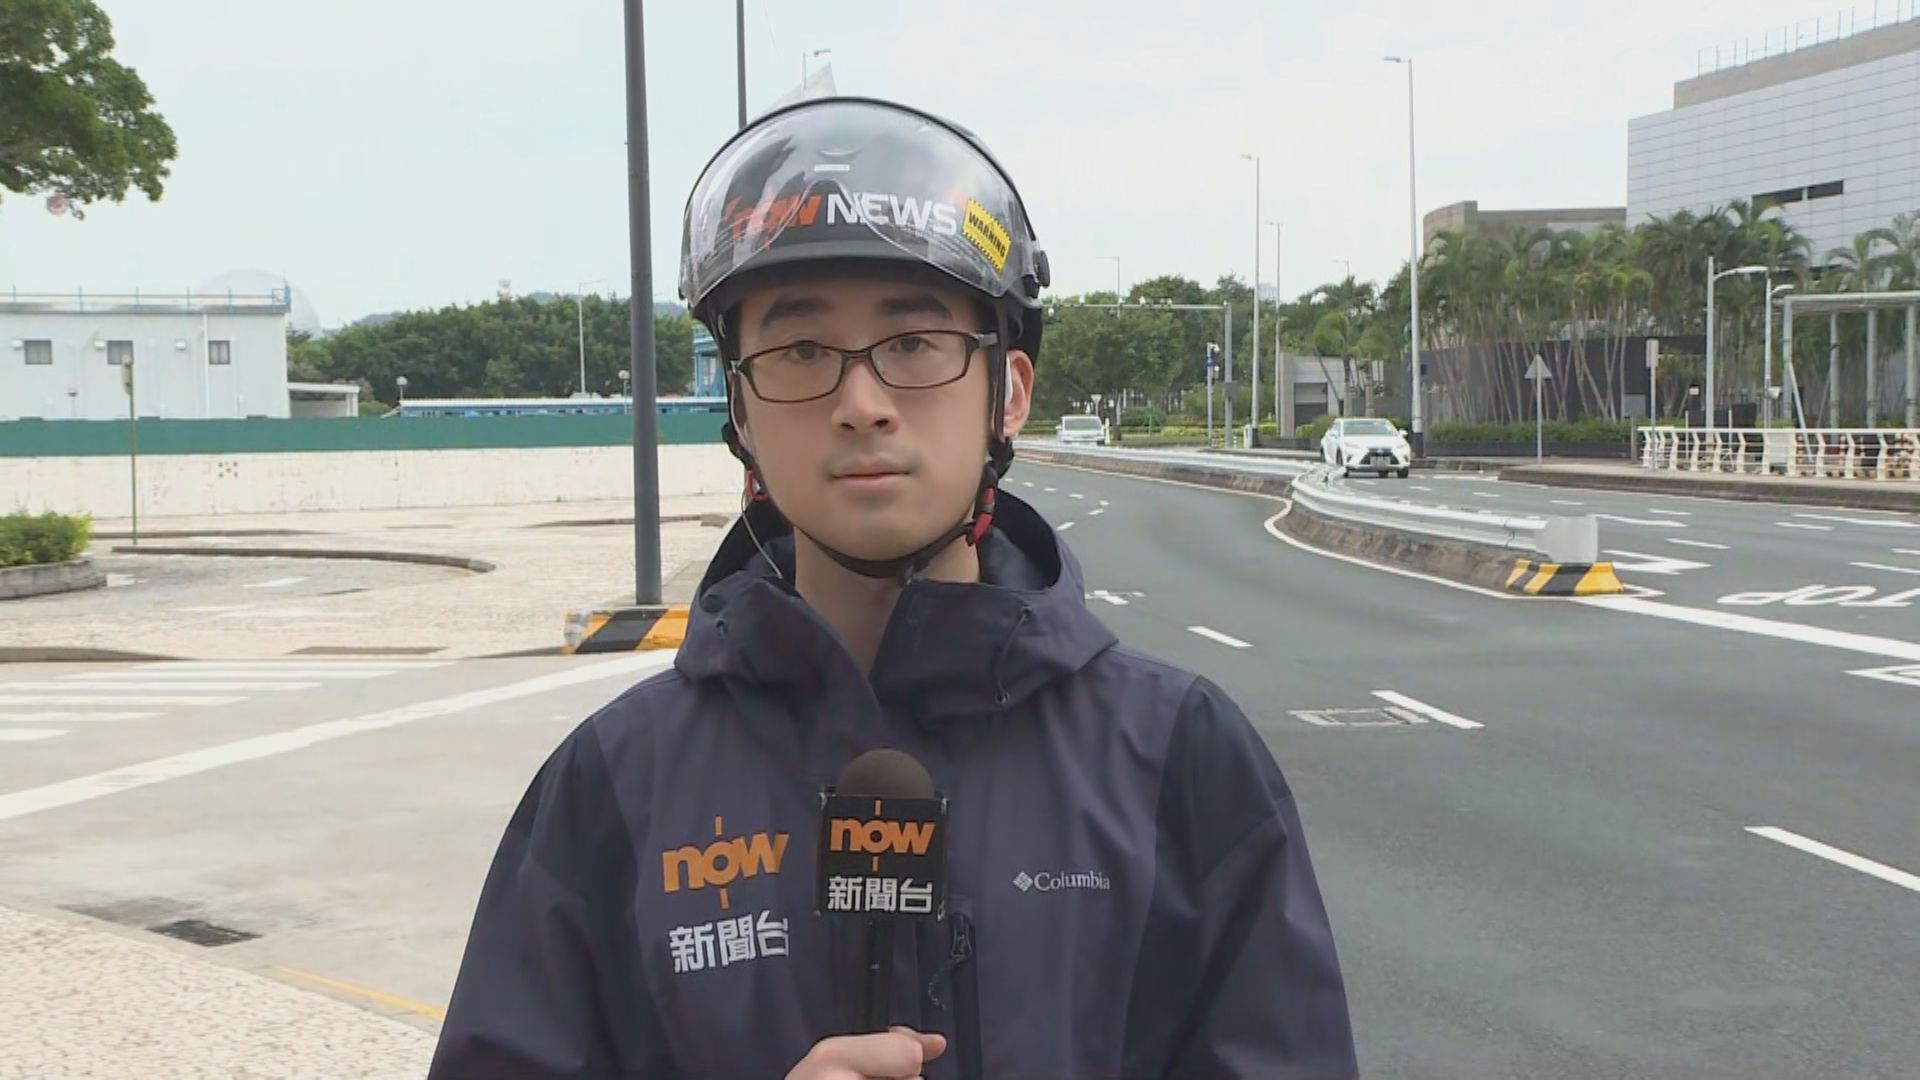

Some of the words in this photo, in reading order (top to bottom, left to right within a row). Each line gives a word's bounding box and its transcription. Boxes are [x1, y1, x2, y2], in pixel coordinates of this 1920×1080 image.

[826, 193, 958, 236] NEWS
[968, 211, 1006, 258] WARNING
[830, 812, 936, 860] now
[662, 826, 789, 899] now
[1033, 870, 1110, 891] Columbia
[827, 875, 933, 914] 新聞台
[669, 910, 789, 973] 新聞台
